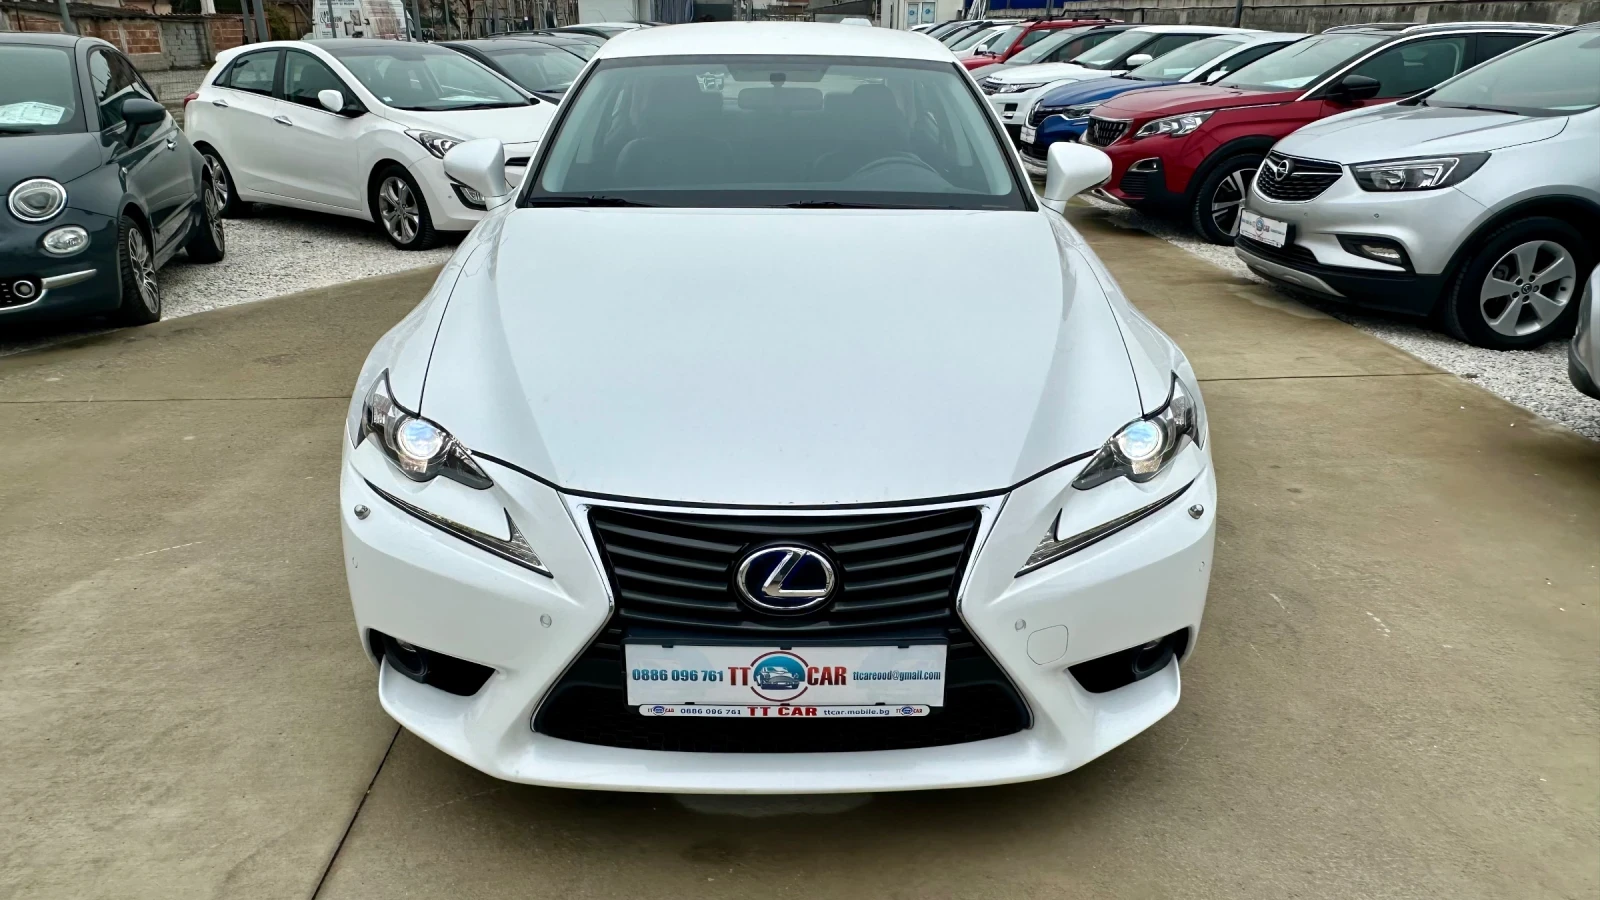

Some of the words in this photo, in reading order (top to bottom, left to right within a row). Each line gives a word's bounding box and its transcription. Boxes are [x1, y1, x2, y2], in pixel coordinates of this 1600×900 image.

[632, 668, 668, 681] 0886
[671, 669, 699, 682] 096
[701, 669, 724, 682] 761
[728, 666, 752, 686] TT
[807, 666, 847, 686] CAR
[853, 670, 941, 682] ttcareood@gmail.com
[747, 706, 771, 717] TT
[778, 706, 818, 717] CAR
[823, 707, 890, 716] ttcar.mobile.bg
